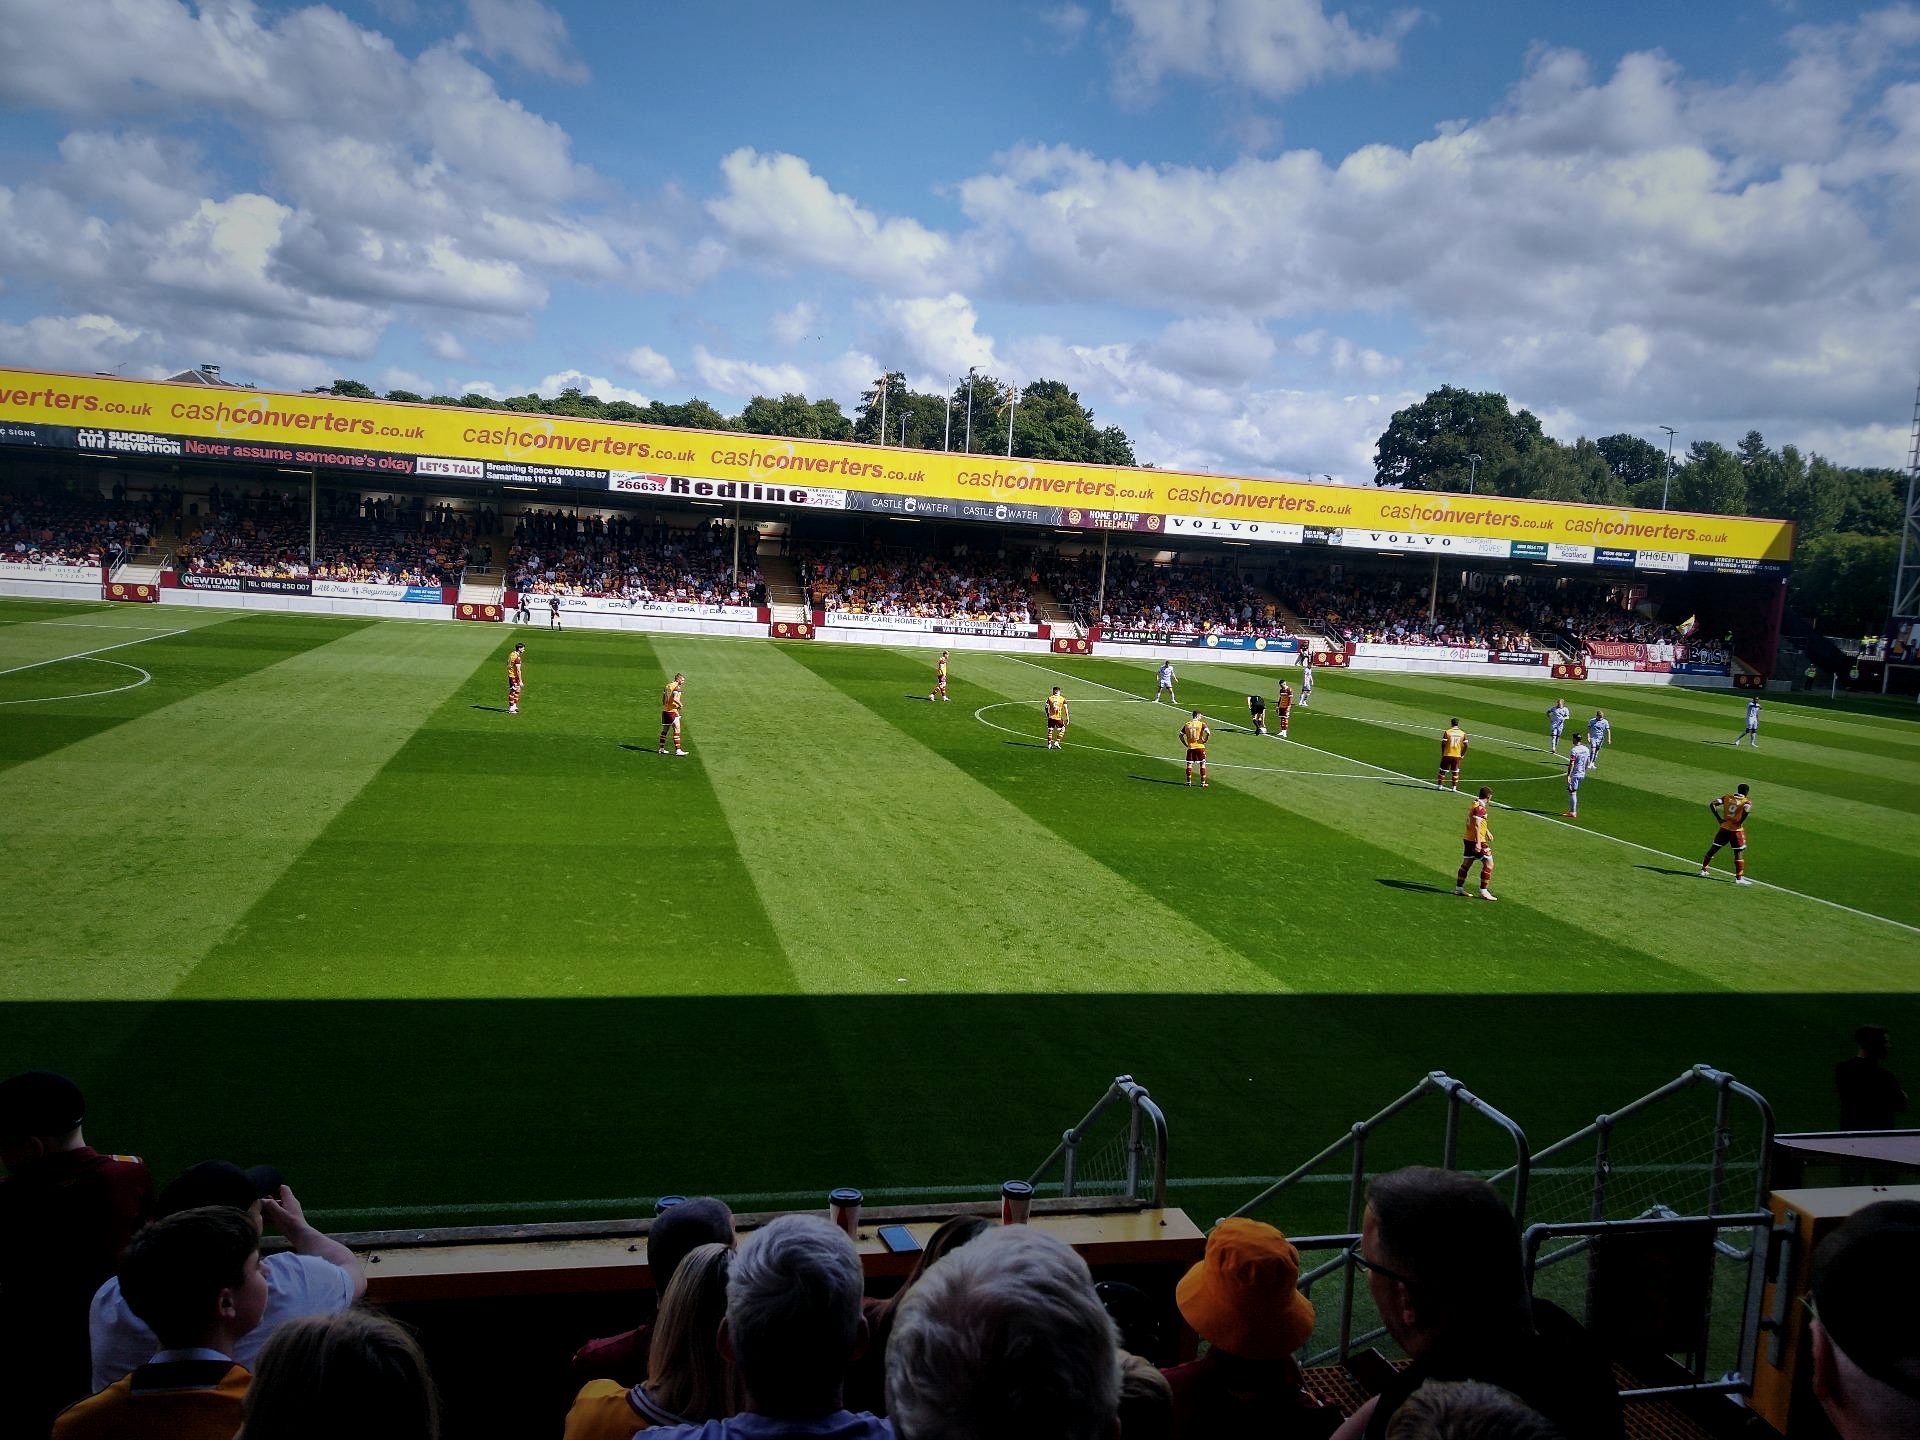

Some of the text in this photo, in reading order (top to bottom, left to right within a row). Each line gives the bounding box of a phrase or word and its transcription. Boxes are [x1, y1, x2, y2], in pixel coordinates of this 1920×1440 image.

[9, 428, 36, 437] SIGNS
[108, 431, 155, 444] SUICIDE
[108, 440, 181, 454] PREVENTION
[185, 440, 414, 474] Never assume someone's okay
[420, 461, 481, 475] LET'S TALK
[487, 462, 527, 475] Breathing
[527, 465, 554, 477] Space
[487, 471, 533, 483] Samaritans
[548, 476, 561, 485] 123
[617, 480, 665, 492] 266633
[670, 476, 808, 504] Redline
[871, 498, 949, 514] CASTLE WATER
[963, 506, 1039, 520] CASTLE WATER
[1089, 510, 1140, 522] HOME OF THE
[1094, 519, 1133, 530] STEELMEN
[1173, 518, 1260, 533] VOLVO
[1370, 533, 1451, 546] VOLVO
[1561, 550, 1588, 560] Scotland
[185, 575, 240, 586] NEWTOWN
[360, 586, 402, 598] Beginnings
[837, 613, 870, 622] BALMER
[871, 615, 893, 623] CARE
[894, 617, 923, 625] HOMES
[1460, 649, 1469, 660] G4
